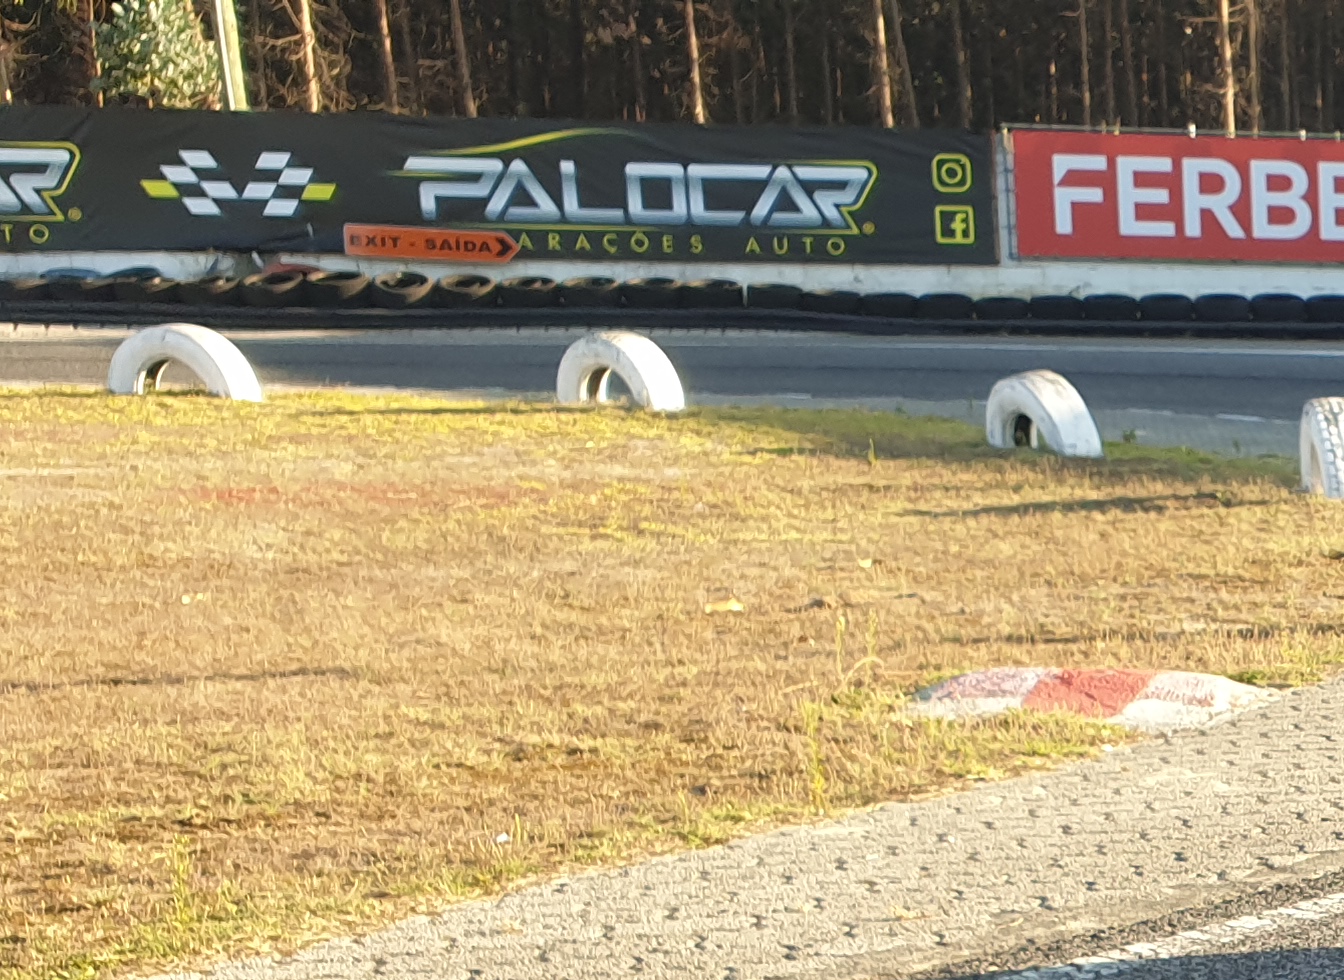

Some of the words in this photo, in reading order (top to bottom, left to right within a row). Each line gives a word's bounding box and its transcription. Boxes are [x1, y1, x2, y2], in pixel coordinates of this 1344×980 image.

[403, 156, 870, 229] PALOCAR
[350, 234, 401, 248] EXIT
[425, 236, 493, 253] SAÍDA
[517, 230, 704, 256] ARAÇÕES
[745, 236, 846, 257] AUTO
